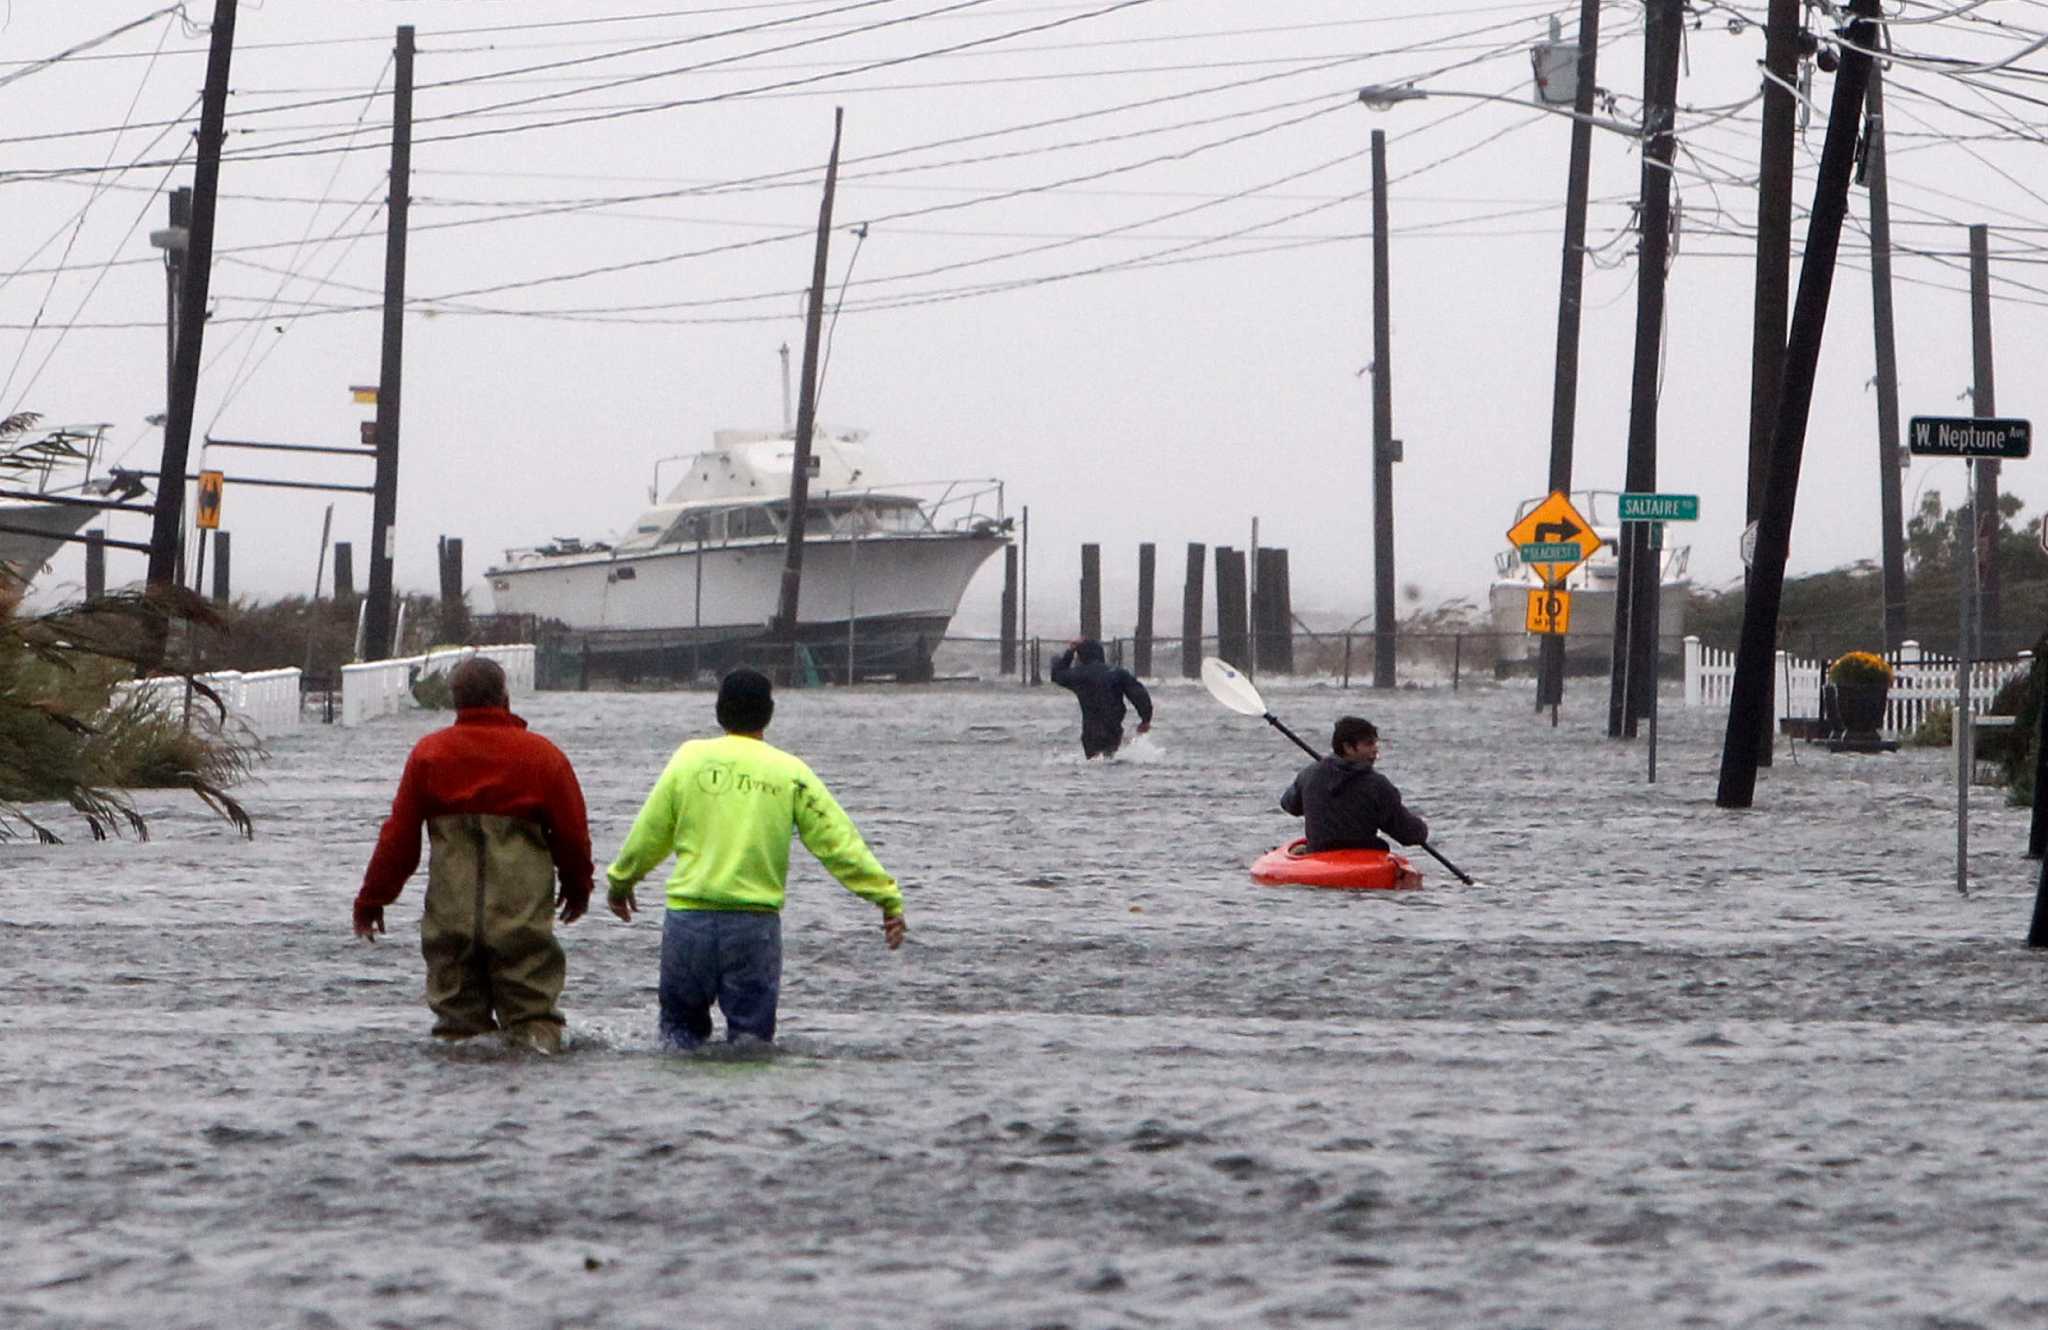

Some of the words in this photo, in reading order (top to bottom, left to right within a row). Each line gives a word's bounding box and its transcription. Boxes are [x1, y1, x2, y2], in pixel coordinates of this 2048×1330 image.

[1915, 423, 1932, 447] W.
[1938, 423, 2006, 453] Neptune
[1625, 498, 1680, 516] SALTAIRE
[1536, 597, 1562, 617] 10
